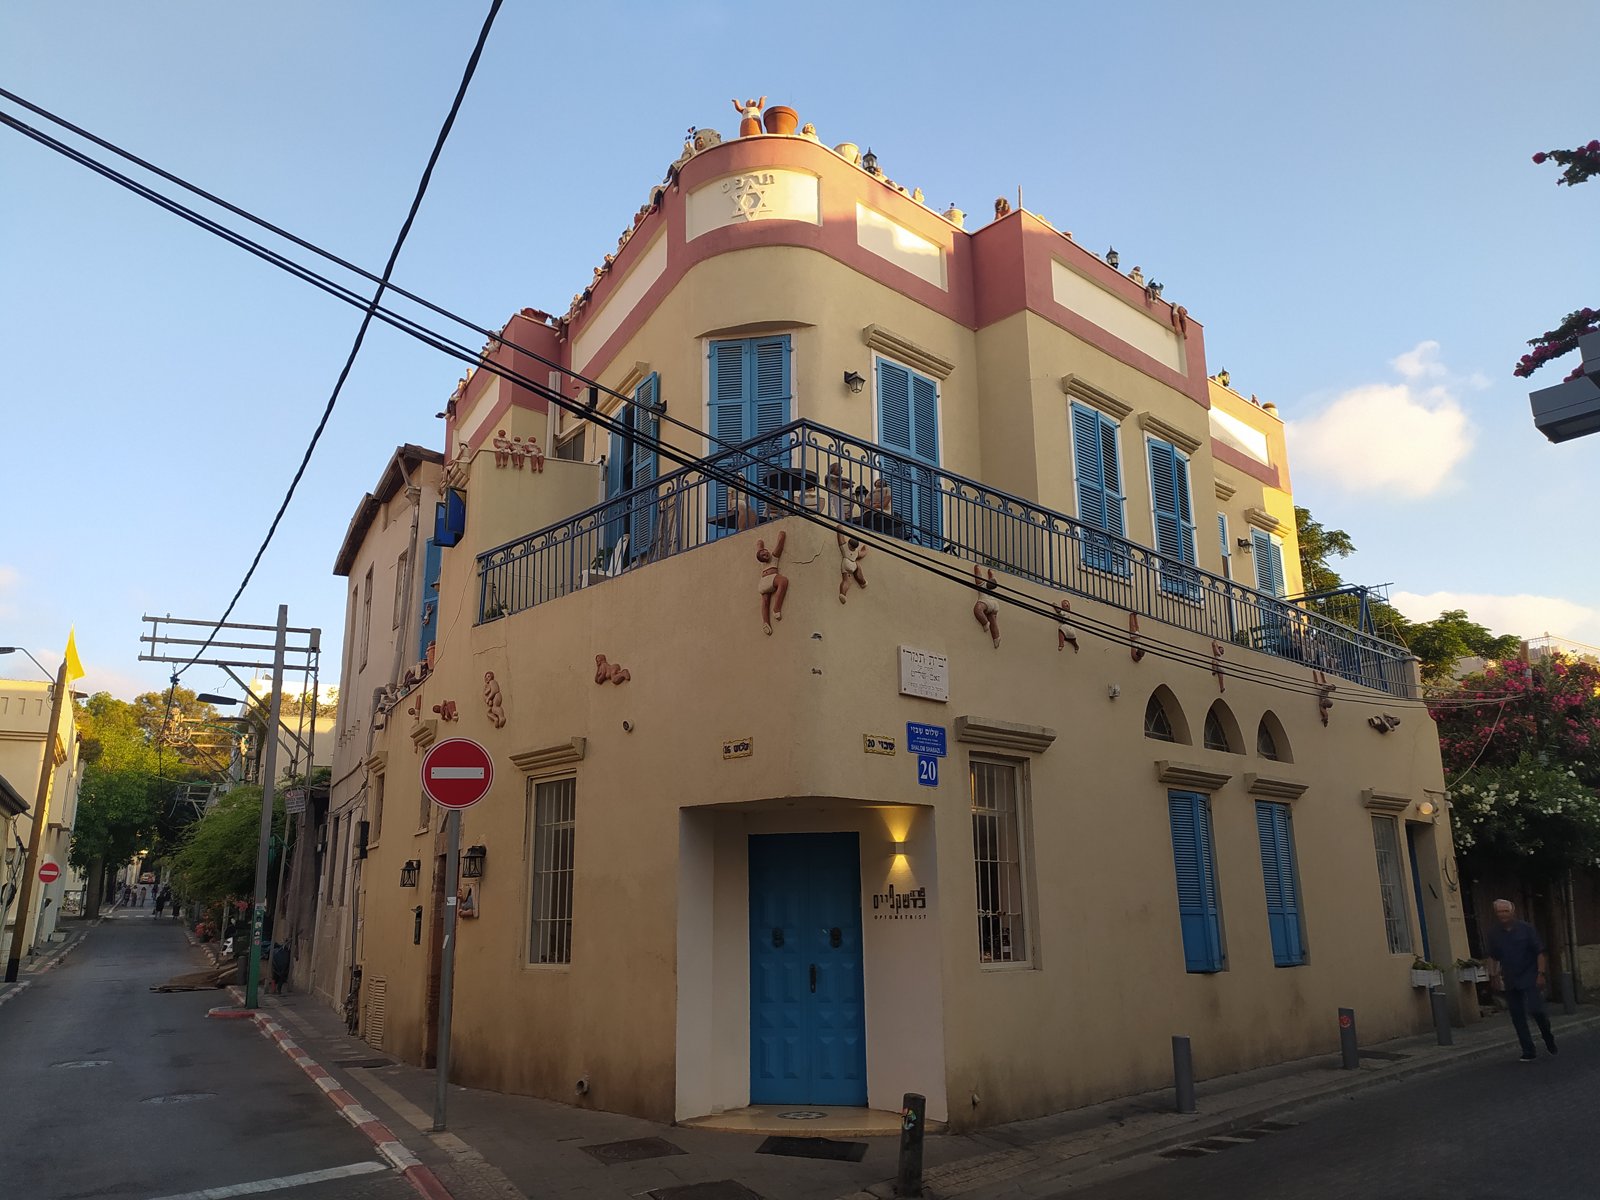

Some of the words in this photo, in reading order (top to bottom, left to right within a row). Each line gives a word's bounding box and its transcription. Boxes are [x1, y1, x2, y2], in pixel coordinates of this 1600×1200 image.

[910, 726, 924, 735] שבזי
[924, 728, 939, 737] שלום
[878, 740, 895, 751] שבזי
[911, 744, 925, 752] SHALOM
[926, 746, 940, 754] SHABAZI
[919, 760, 936, 781] 20
